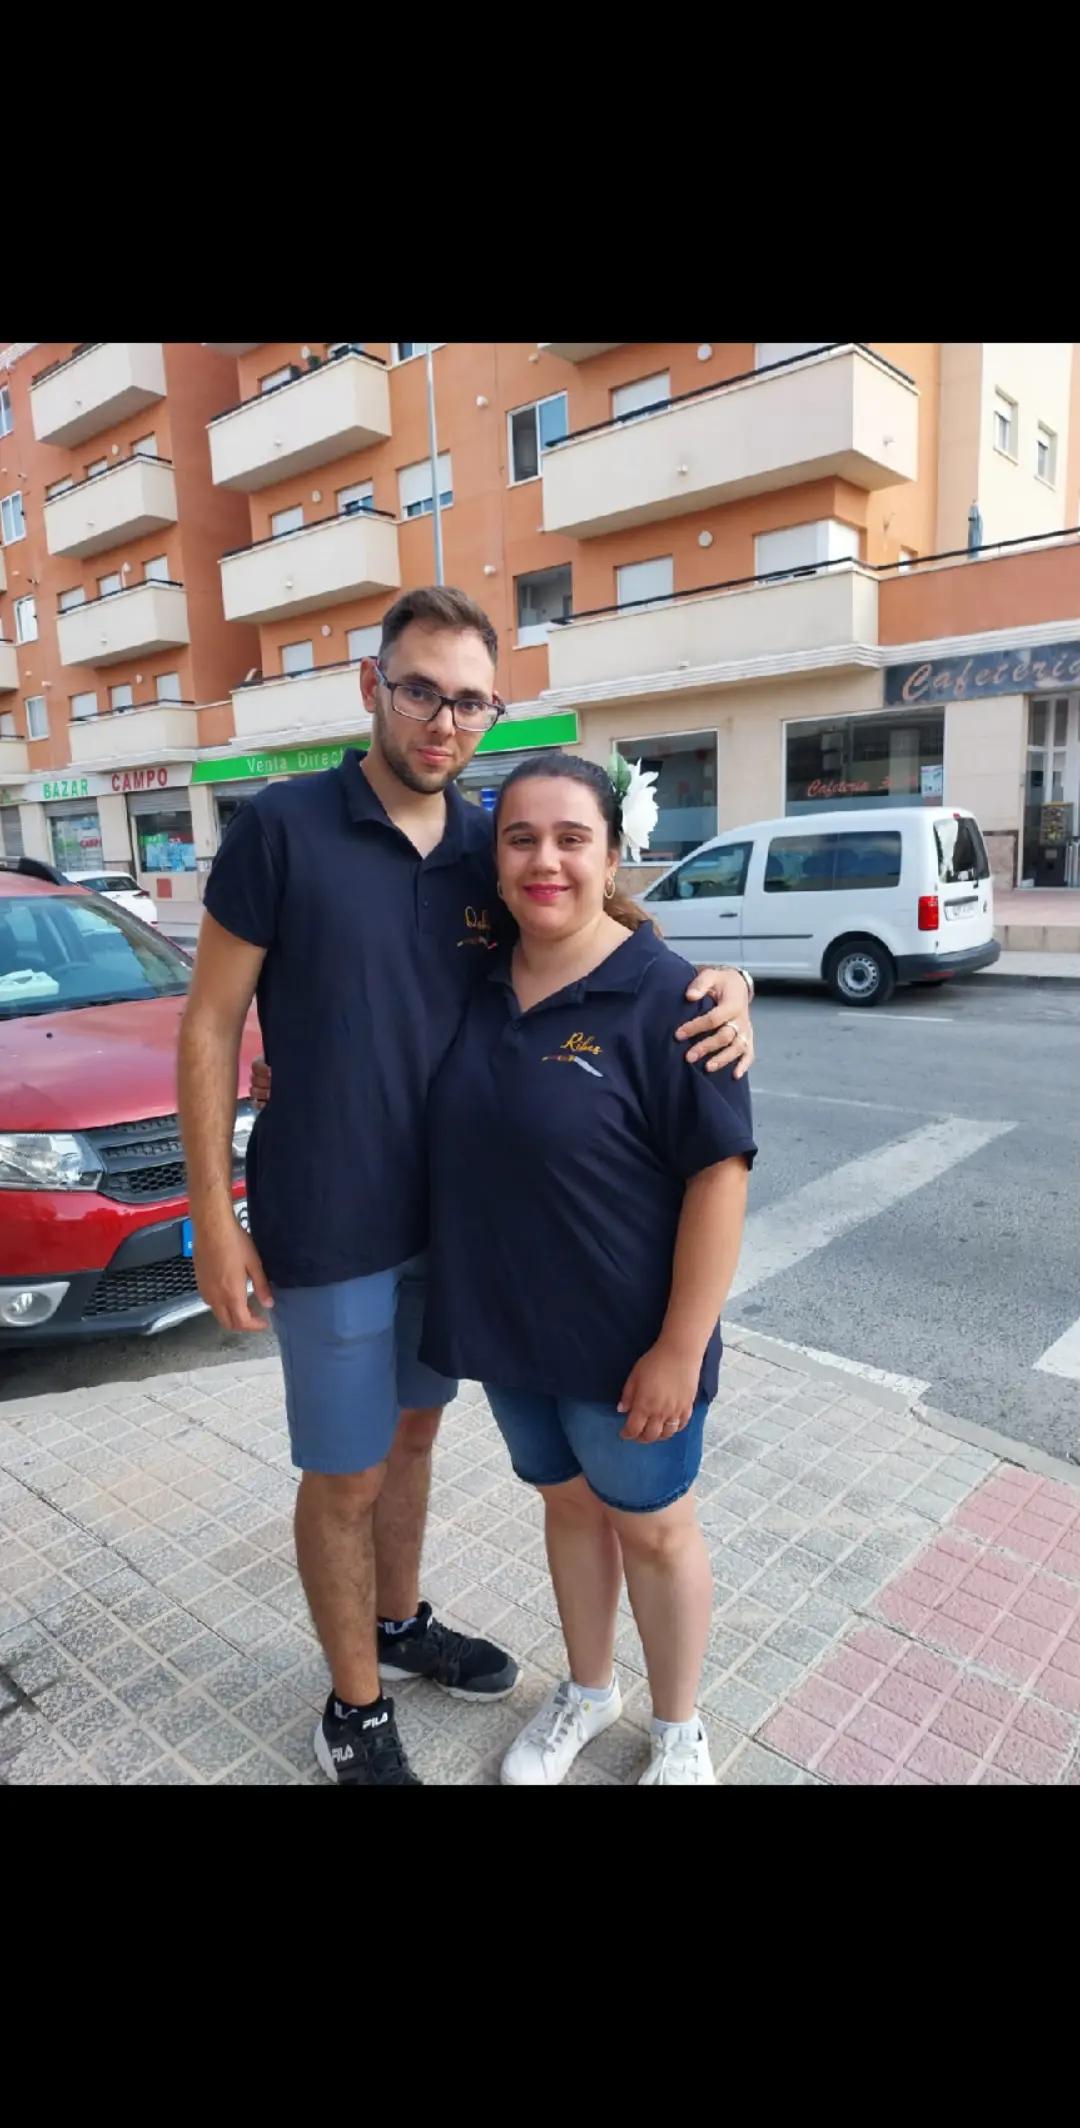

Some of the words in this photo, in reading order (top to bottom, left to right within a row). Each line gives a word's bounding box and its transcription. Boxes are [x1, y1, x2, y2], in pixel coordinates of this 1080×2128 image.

[247, 756, 288, 773] Venta
[297, 749, 344, 769] Direct
[43, 778, 89, 799] BAZAR
[111, 767, 168, 792] CAMPO
[362, 1712, 389, 1730] FILA
[331, 1743, 355, 1763] FILA
